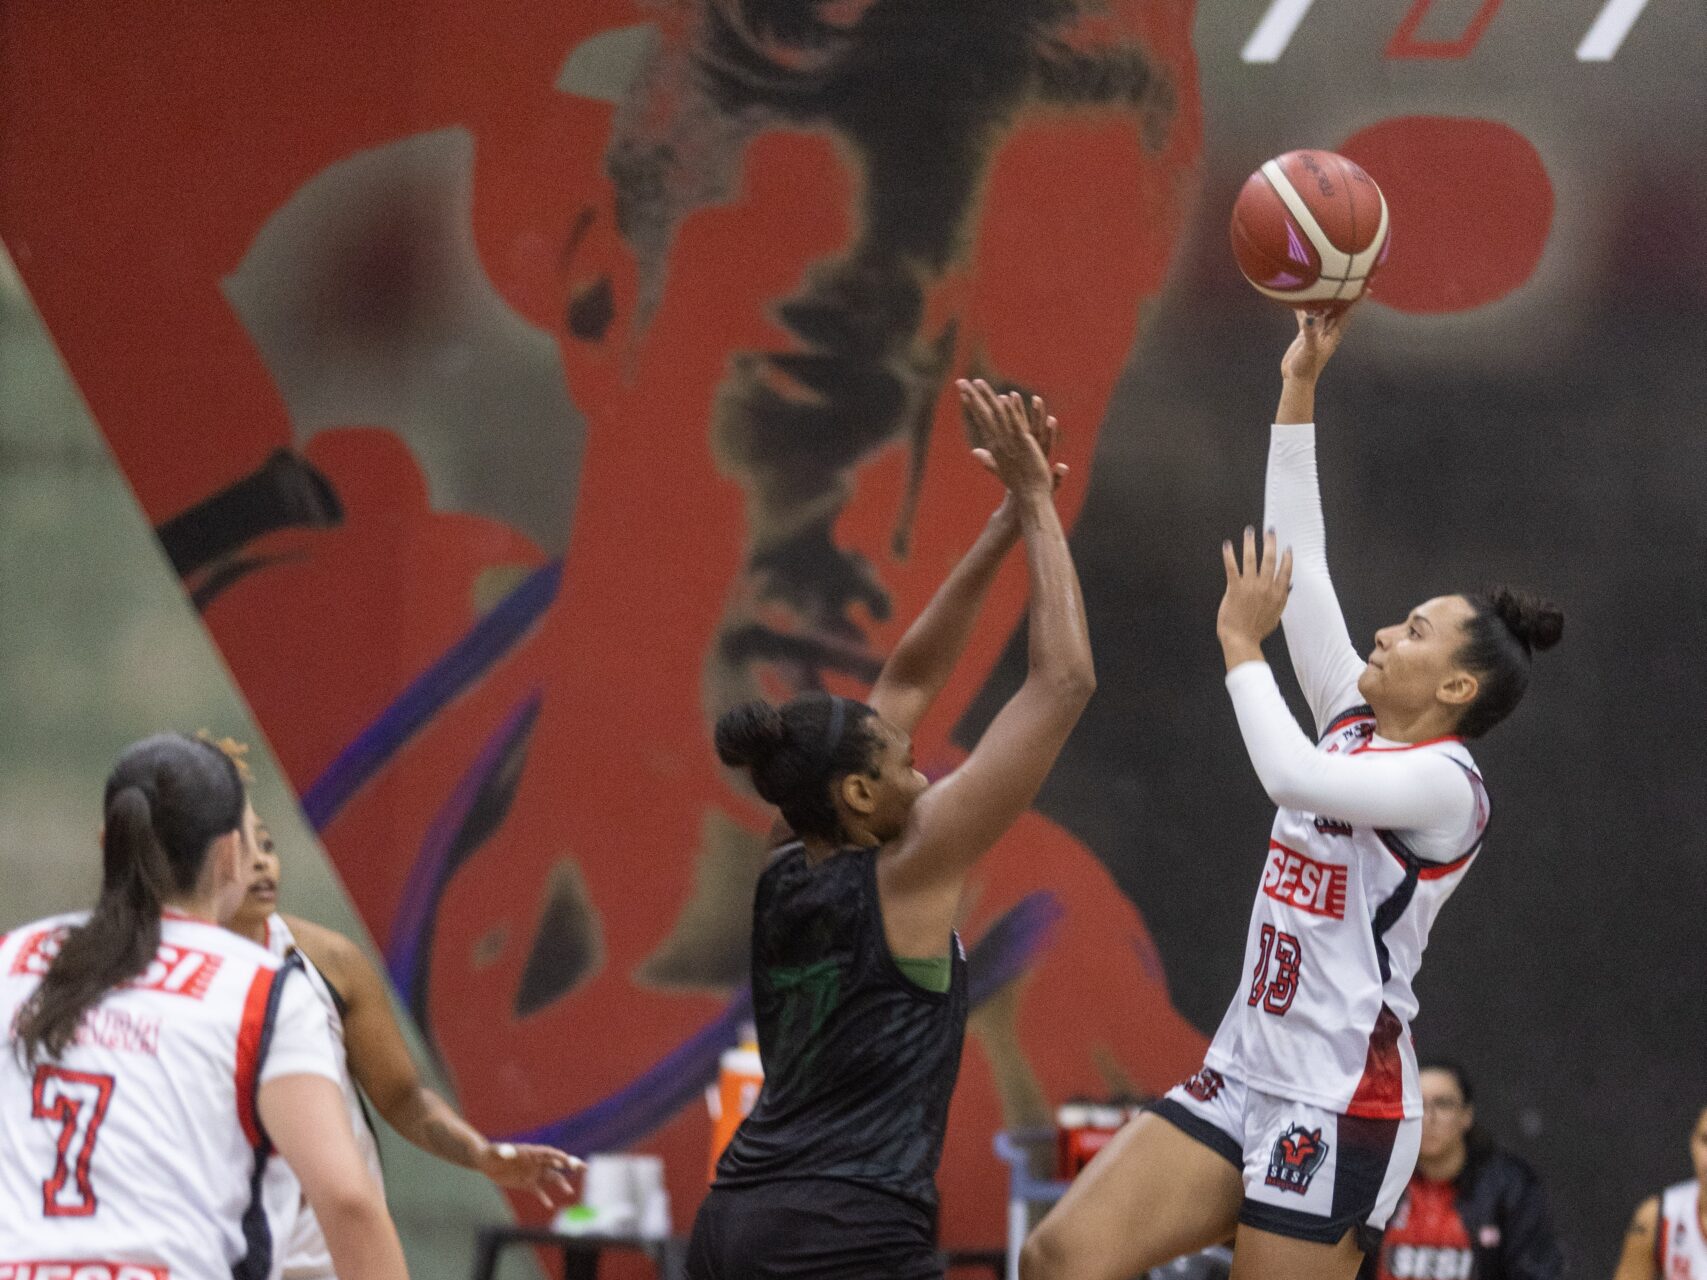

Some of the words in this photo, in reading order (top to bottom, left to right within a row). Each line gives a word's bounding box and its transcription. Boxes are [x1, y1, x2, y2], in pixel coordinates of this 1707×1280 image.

[1265, 847, 1332, 911] SESI
[1248, 923, 1301, 1016] 13
[32, 1064, 115, 1217] 7
[1270, 1165, 1309, 1187] SESI
